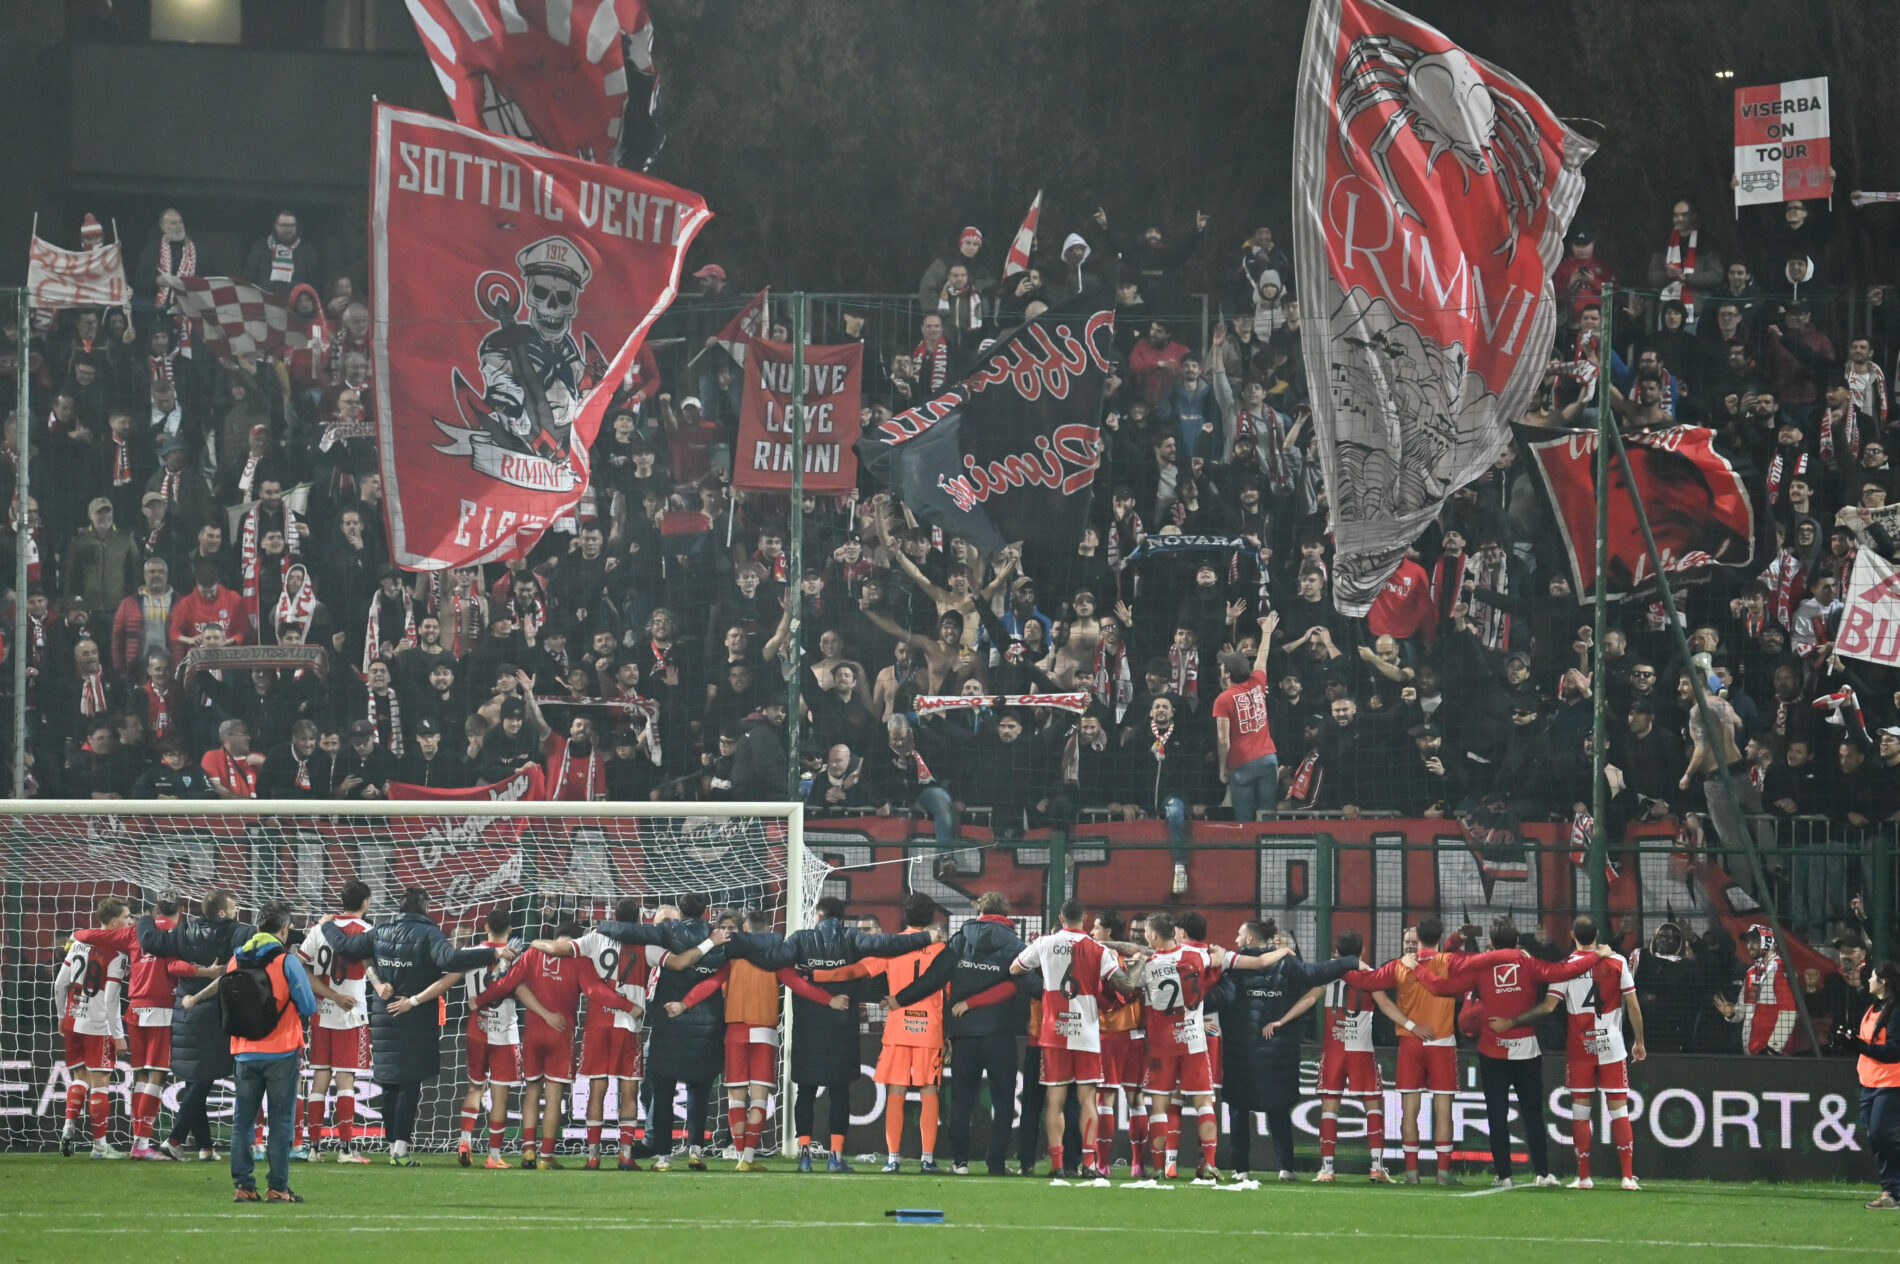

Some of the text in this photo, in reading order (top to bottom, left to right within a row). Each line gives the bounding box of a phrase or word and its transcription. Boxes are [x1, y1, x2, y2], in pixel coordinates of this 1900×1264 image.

[1741, 96, 1821, 118] VISERBA
[1767, 122, 1795, 138] ON
[1756, 144, 1808, 162] TOUR
[399, 142, 521, 216] SOTTO
[533, 170, 563, 222] IL
[545, 242, 568, 262] 1912
[931, 343, 947, 392] RIMIN
[761, 361, 847, 395] NUVE
[1146, 535, 1246, 550] NOVARA
[72, 954, 103, 998] 28
[599, 948, 639, 988] 97
[964, 961, 1001, 972] GIVOVA
[1059, 962, 1080, 1000] 6
[1496, 986, 1522, 994] GIVOVA
[1157, 970, 1203, 1016] 23
[1581, 981, 1605, 1020] 4
[903, 1017, 929, 1026] Servi
[904, 1025, 928, 1033] Tech
[1056, 1020, 1082, 1029] Servi
[1056, 1028, 1081, 1037] Tech
[1583, 1037, 1610, 1046] Servi
[1585, 1045, 1611, 1055] Tech
[1548, 1087, 1862, 1152] SPORT&
